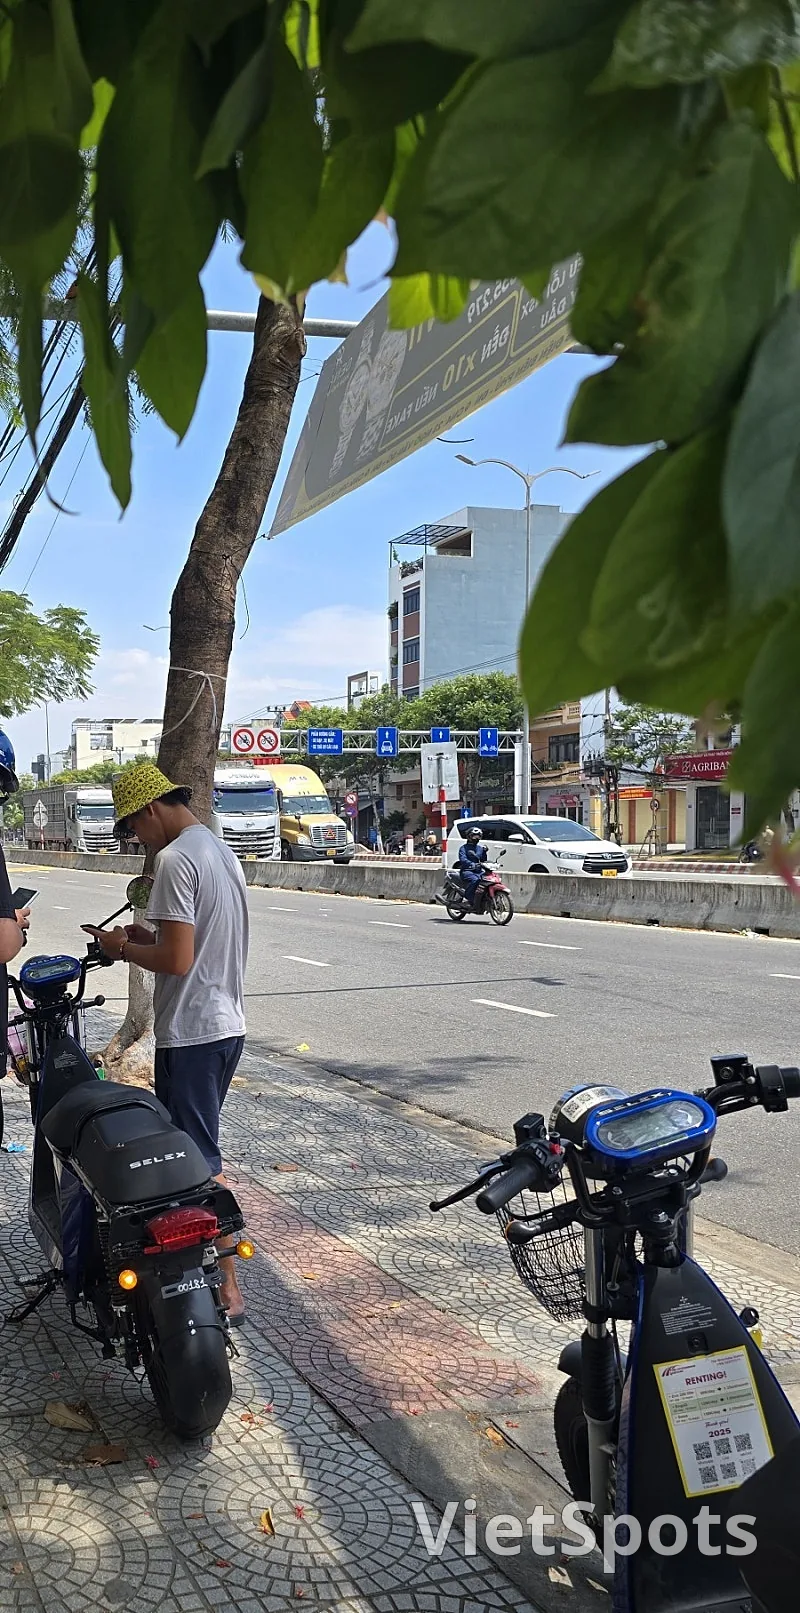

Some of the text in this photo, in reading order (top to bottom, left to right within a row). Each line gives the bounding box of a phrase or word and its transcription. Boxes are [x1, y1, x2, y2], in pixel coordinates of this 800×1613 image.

[129, 1151, 187, 1170] SELEX
[685, 1371, 727, 1386] RENTING!
[708, 1428, 732, 1438] 2025
